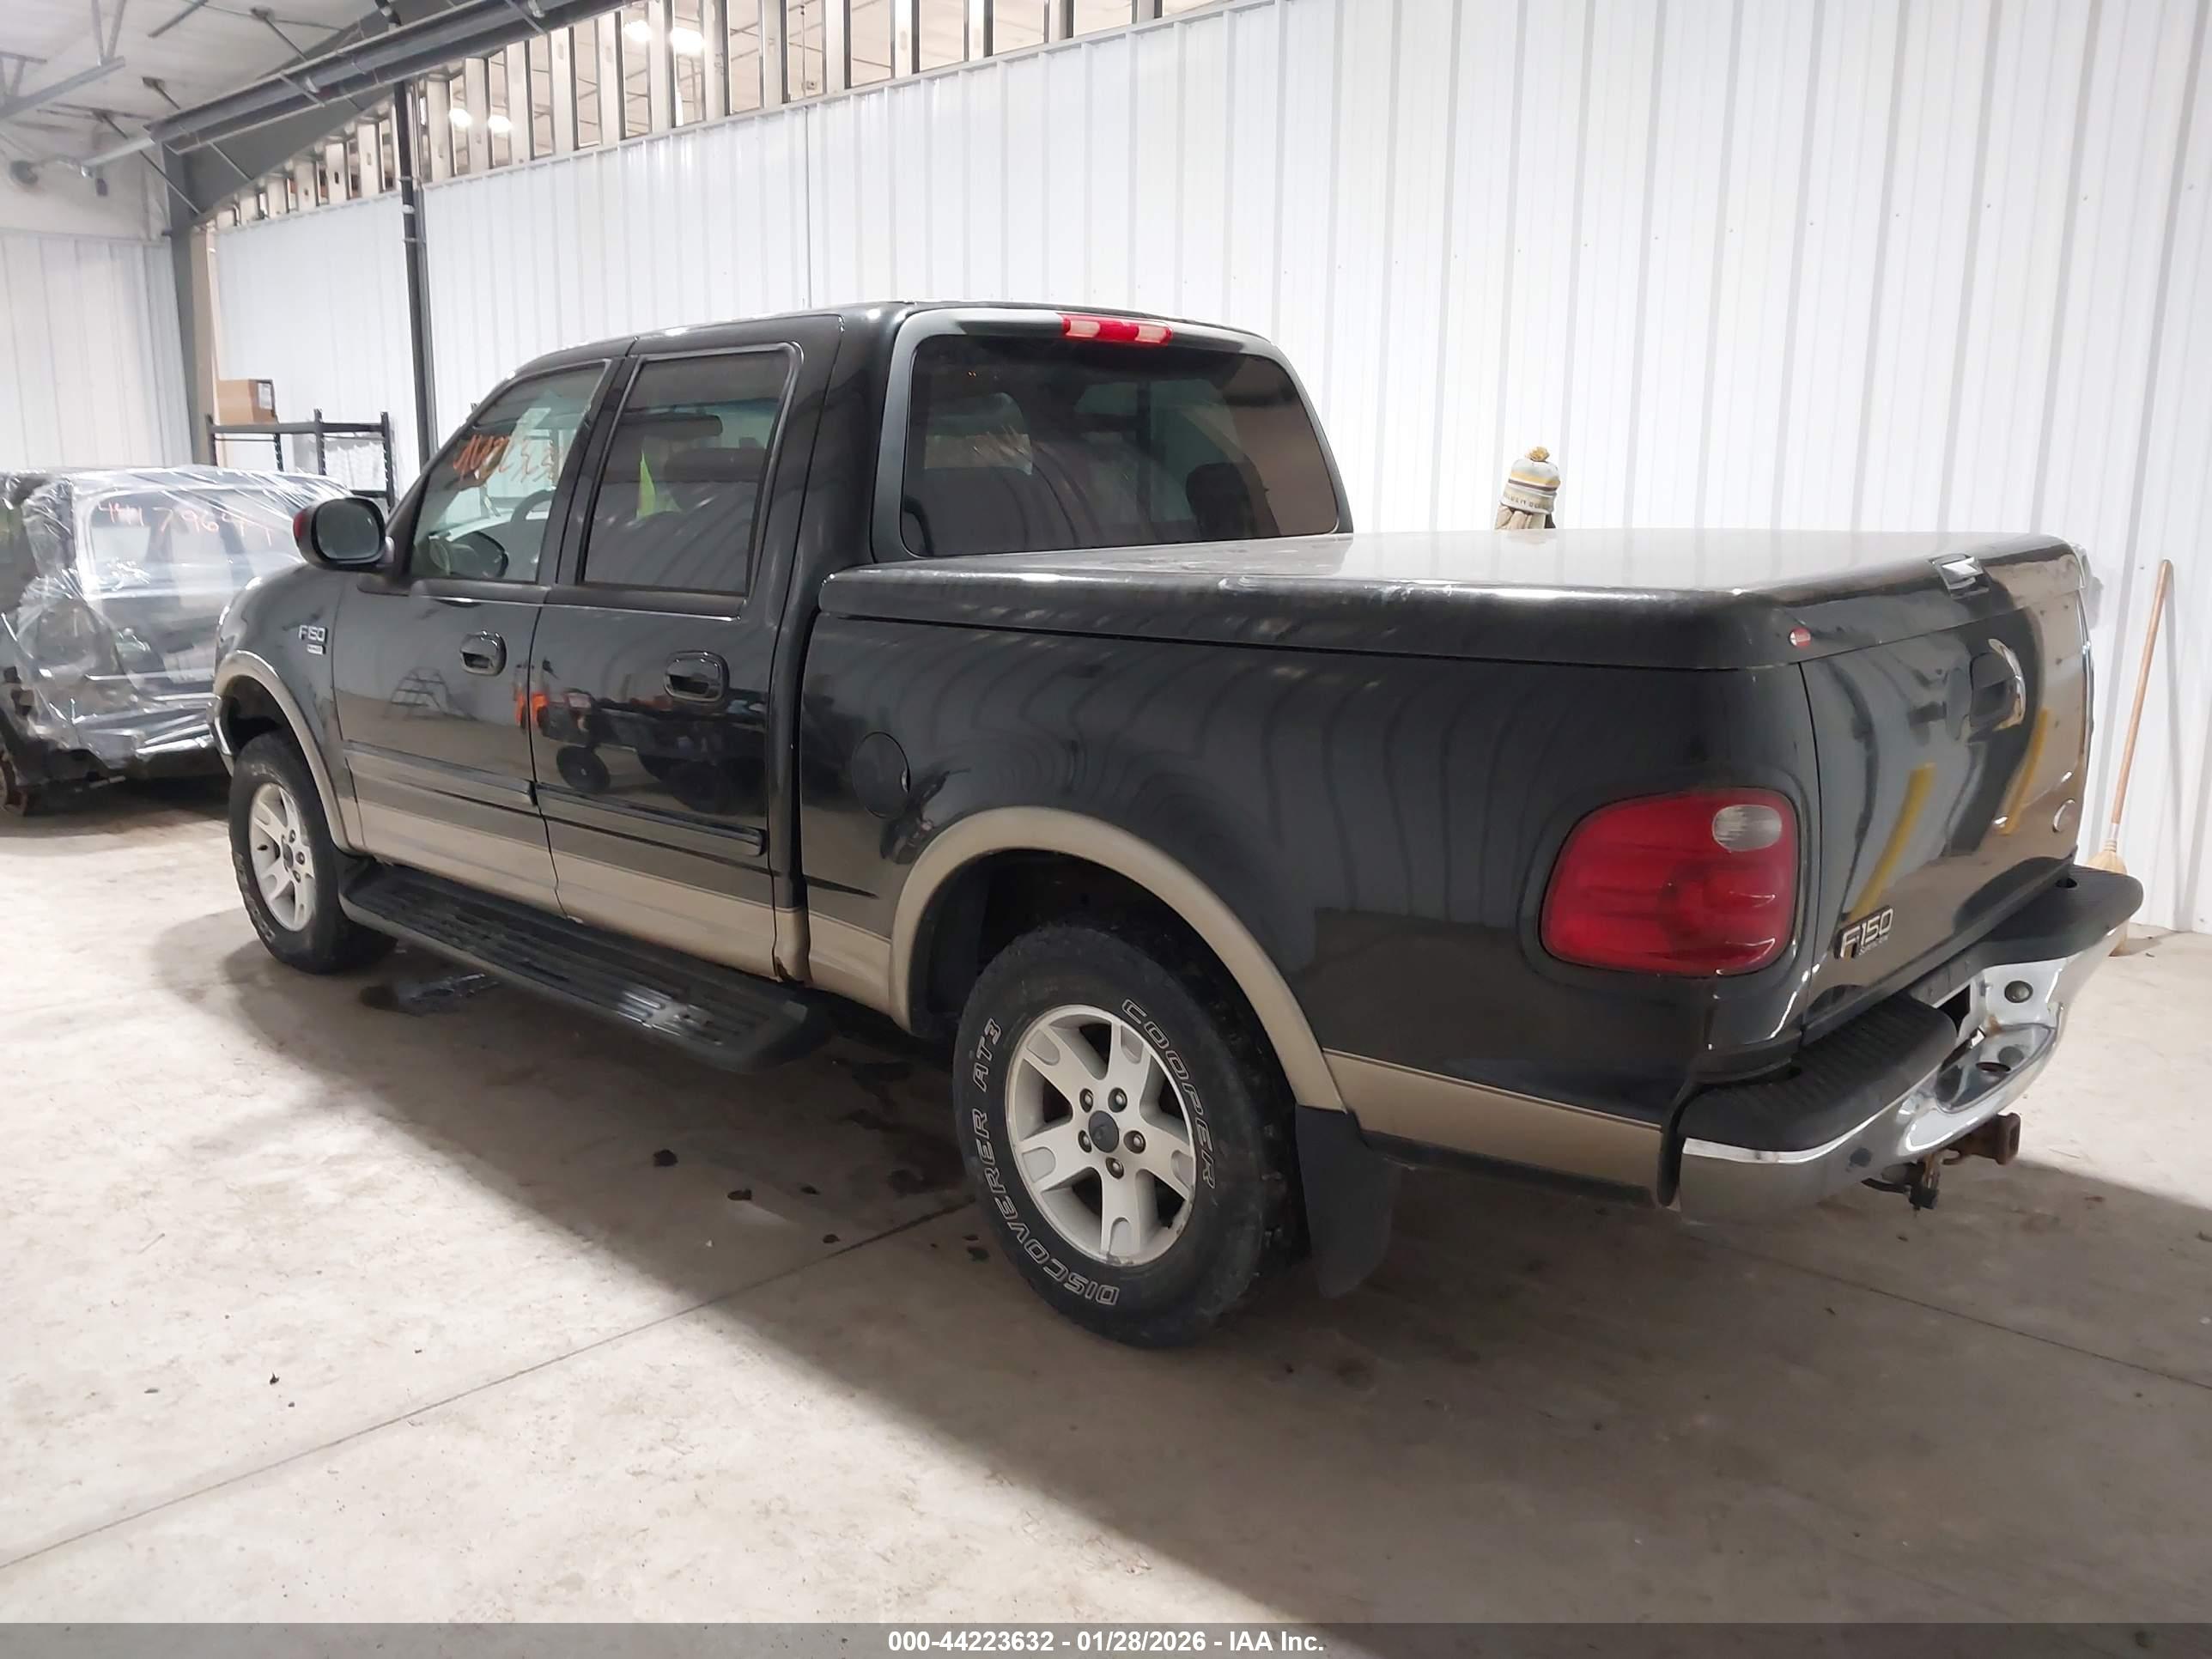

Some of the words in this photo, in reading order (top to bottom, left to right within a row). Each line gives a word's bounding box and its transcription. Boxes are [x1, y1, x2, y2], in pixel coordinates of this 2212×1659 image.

[299, 624, 325, 642] F150
[1839, 908, 1893, 958] F150
[1121, 998, 1217, 1189] COOPER
[972, 1108, 1121, 1307] DISCOVERER
